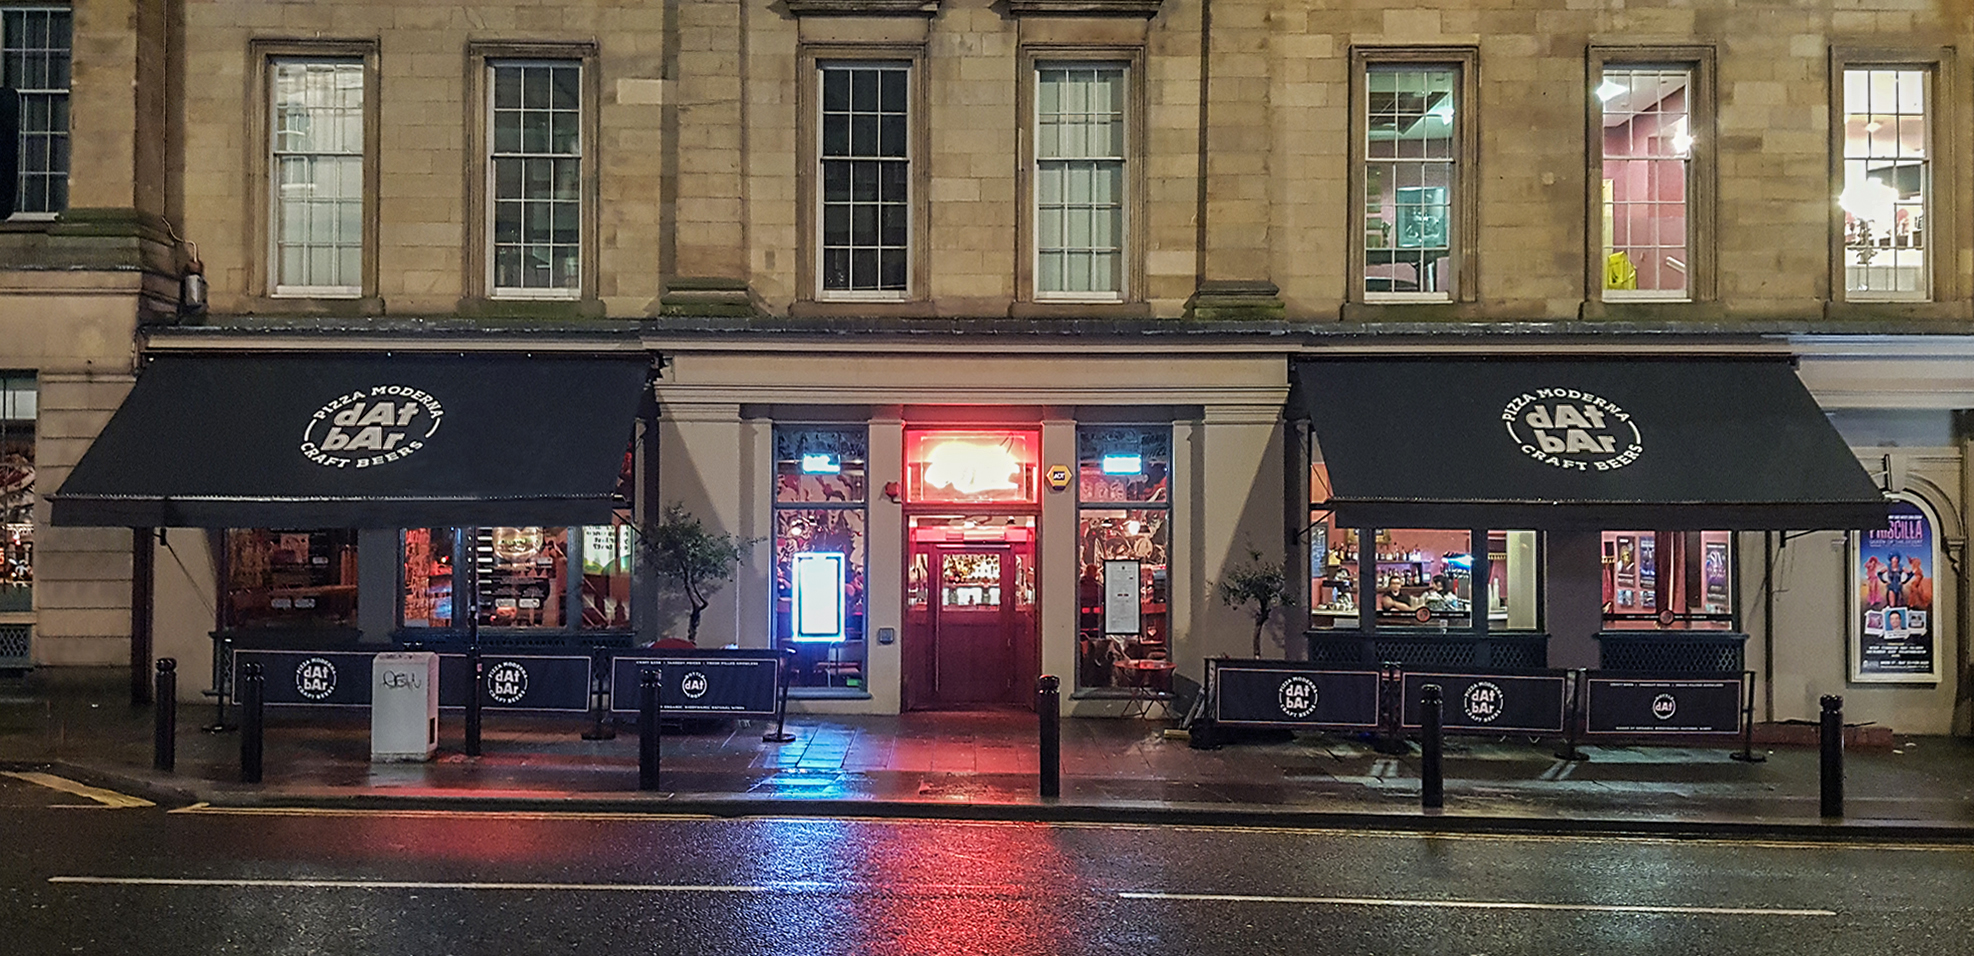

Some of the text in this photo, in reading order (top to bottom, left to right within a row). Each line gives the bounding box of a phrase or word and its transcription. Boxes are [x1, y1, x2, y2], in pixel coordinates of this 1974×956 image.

[313, 385, 445, 419] PIZZA MODERNA
[333, 402, 419, 426] dAt
[1502, 388, 1631, 422] PIZZA MODERNA
[1525, 404, 1606, 429] dAt
[320, 426, 405, 451] bAr
[1533, 429, 1616, 453] bAr
[300, 441, 423, 468] CRAFT BEERS
[1521, 444, 1643, 470] CRAFT BEERS
